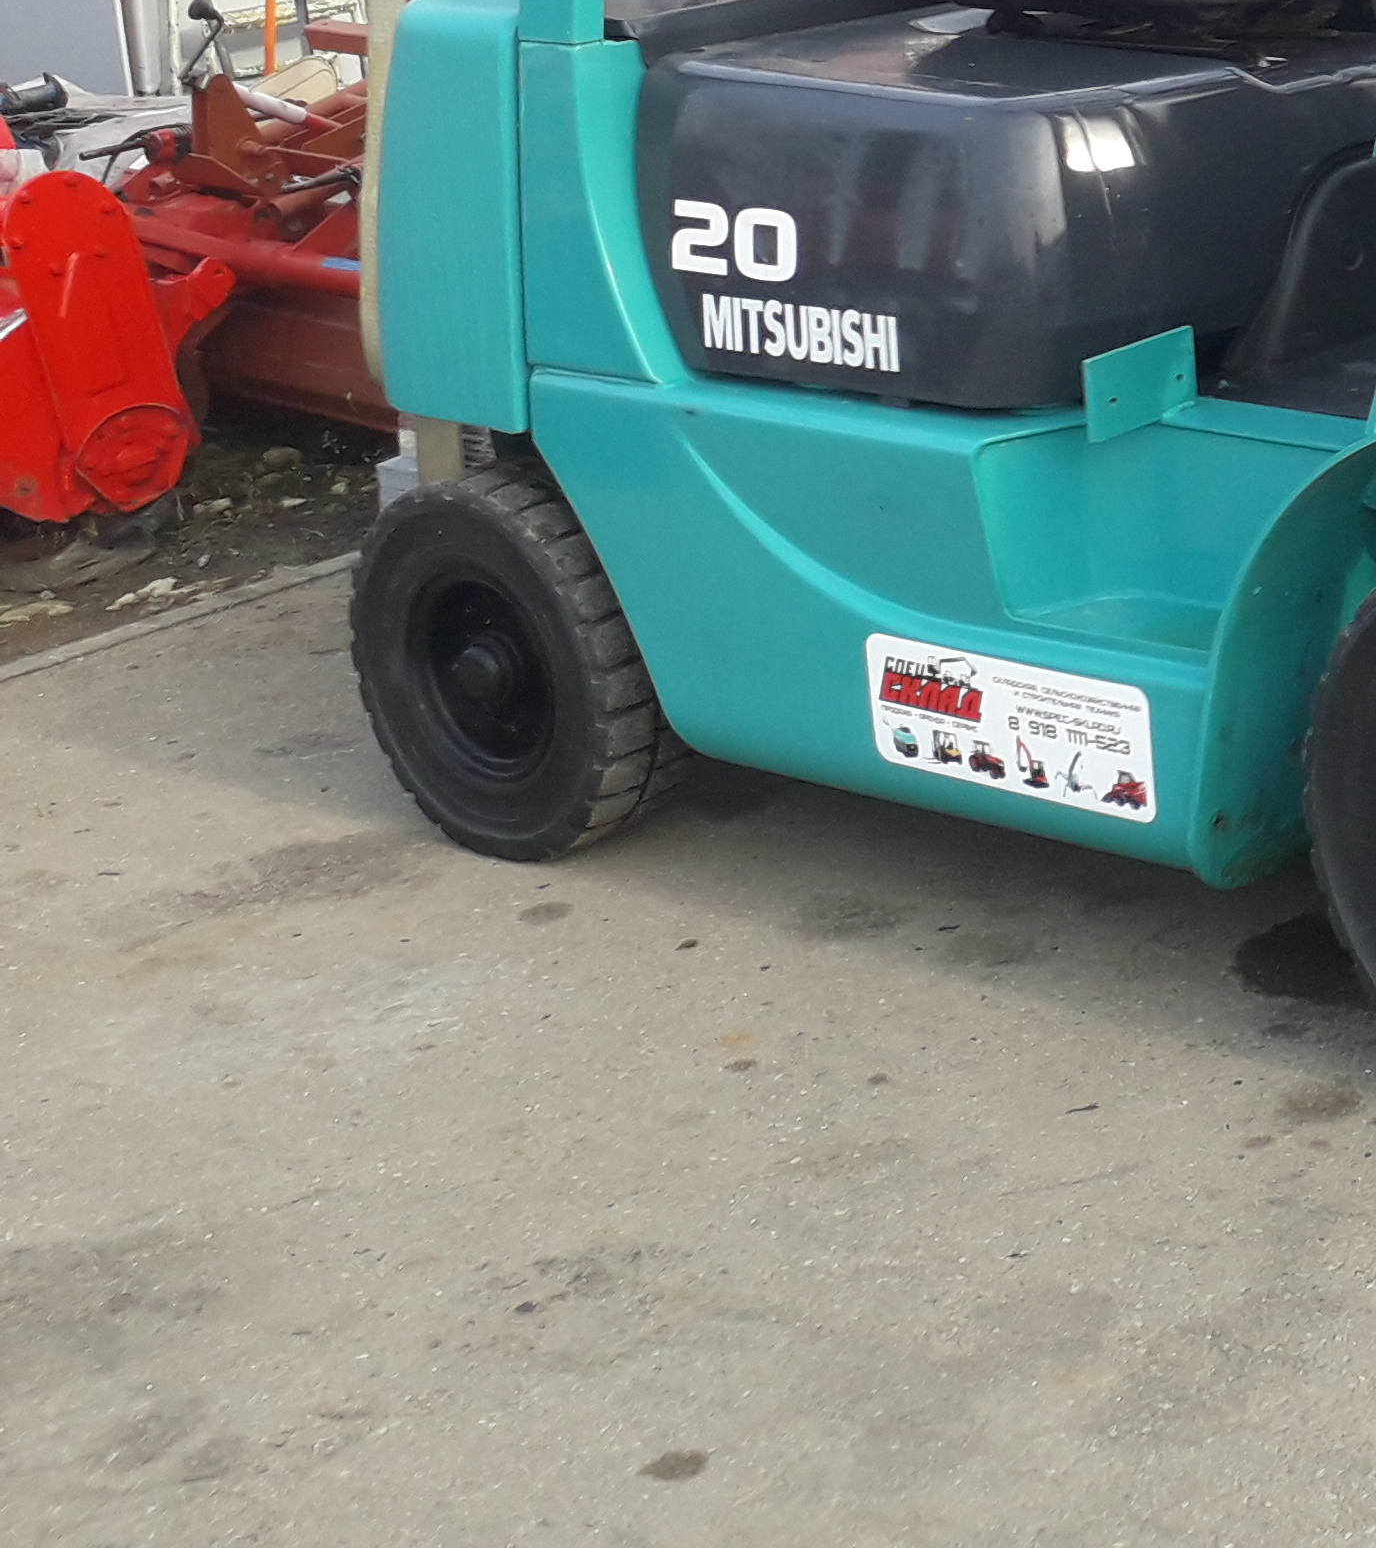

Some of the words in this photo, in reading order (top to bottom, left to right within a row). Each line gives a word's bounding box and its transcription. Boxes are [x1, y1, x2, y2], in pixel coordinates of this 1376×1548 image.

[671, 199, 797, 282] 20
[702, 293, 900, 372] MITSUBISHI
[879, 671, 983, 723] СКЛАД
[1007, 715, 1020, 731] 8
[1028, 719, 1058, 739] 918
